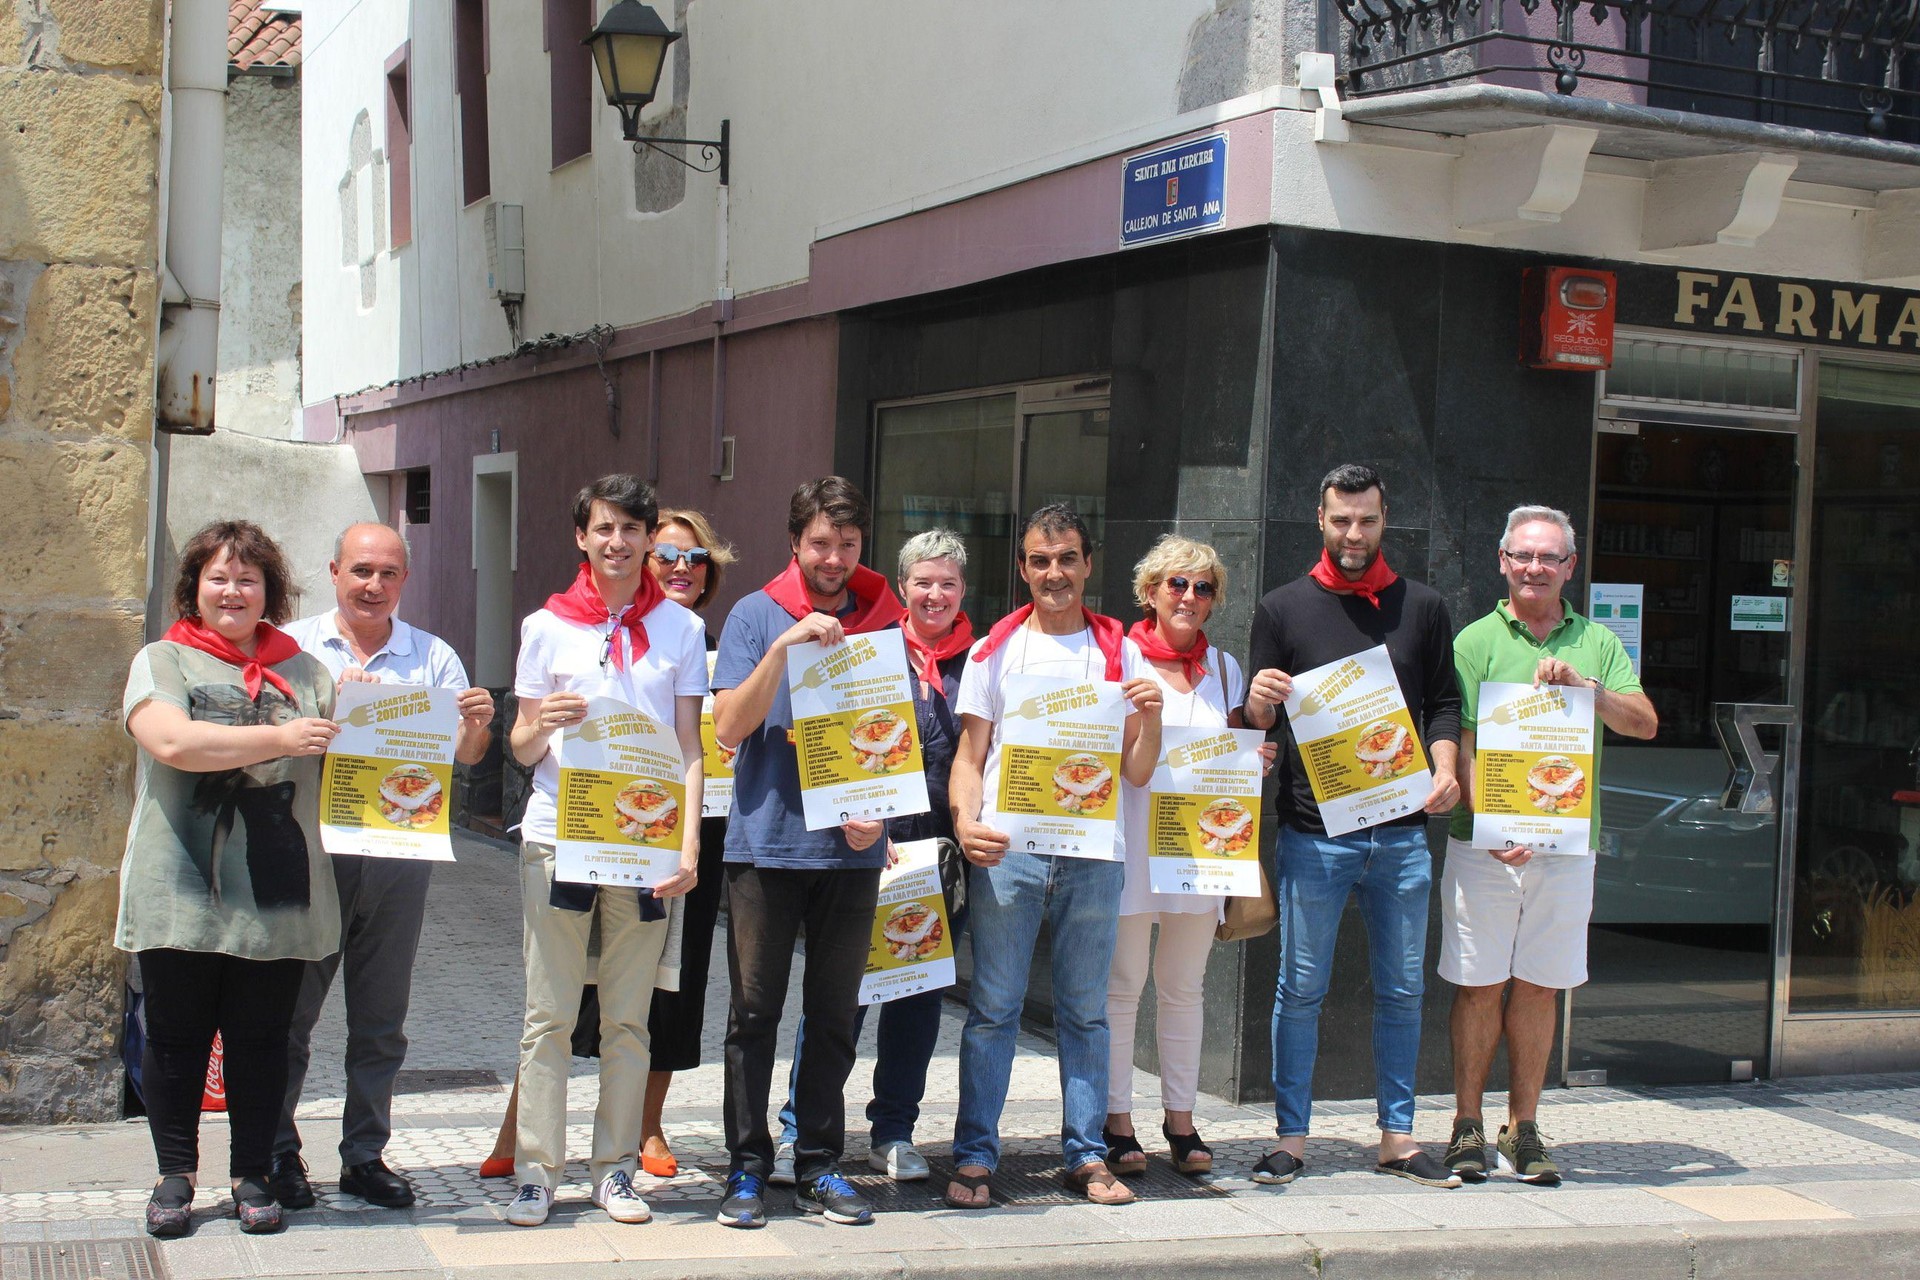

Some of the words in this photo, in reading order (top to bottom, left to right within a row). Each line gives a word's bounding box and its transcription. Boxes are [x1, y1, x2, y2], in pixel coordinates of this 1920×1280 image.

[1135, 164, 1158, 181] SANTA
[1161, 159, 1176, 175] ANA
[1179, 149, 1214, 170] KARKABA
[1125, 215, 1158, 233] CALLEJON
[1162, 211, 1171, 225] DE
[1174, 206, 1197, 222] SANTA
[1203, 200, 1220, 216] ANA
[1674, 272, 1920, 348] FARMA
[820, 637, 871, 668] LASARTE-ORIA
[827, 646, 877, 679] 2017/07/26
[1314, 659, 1358, 694] LASARTE-ORIA
[1321, 666, 1365, 703] 2017/07/26
[372, 690, 428, 709] LASARTE-ORIA
[836, 700, 859, 710] SANTA
[861, 697, 877, 706] ANA
[876, 692, 905, 704] PINTXOA
[1042, 684, 1094, 702] LASARTE-ORIA
[1047, 693, 1098, 715] 2017/07/26
[1513, 689, 1562, 708] LASARTE-ORIA
[376, 700, 431, 723] 2017/07/26
[1337, 717, 1359, 730] SANTA
[1359, 711, 1374, 722] ANA
[1372, 701, 1400, 716] PINTXOA
[1518, 698, 1567, 720] 2017/07/26
[607, 722, 657, 738] 2017/07/26
[1048, 738, 1071, 747] SANTA
[1087, 741, 1115, 750] PINTXOA
[1187, 732, 1234, 751] LASARTE-ORIA
[1191, 741, 1238, 763] 2017/07/26
[374, 747, 399, 757] SANTA
[400, 750, 417, 758] ANA
[416, 751, 446, 761] PINTXOA
[609, 762, 633, 772] SANTA
[636, 765, 652, 774] ANA
[651, 767, 680, 781] PINTXOA
